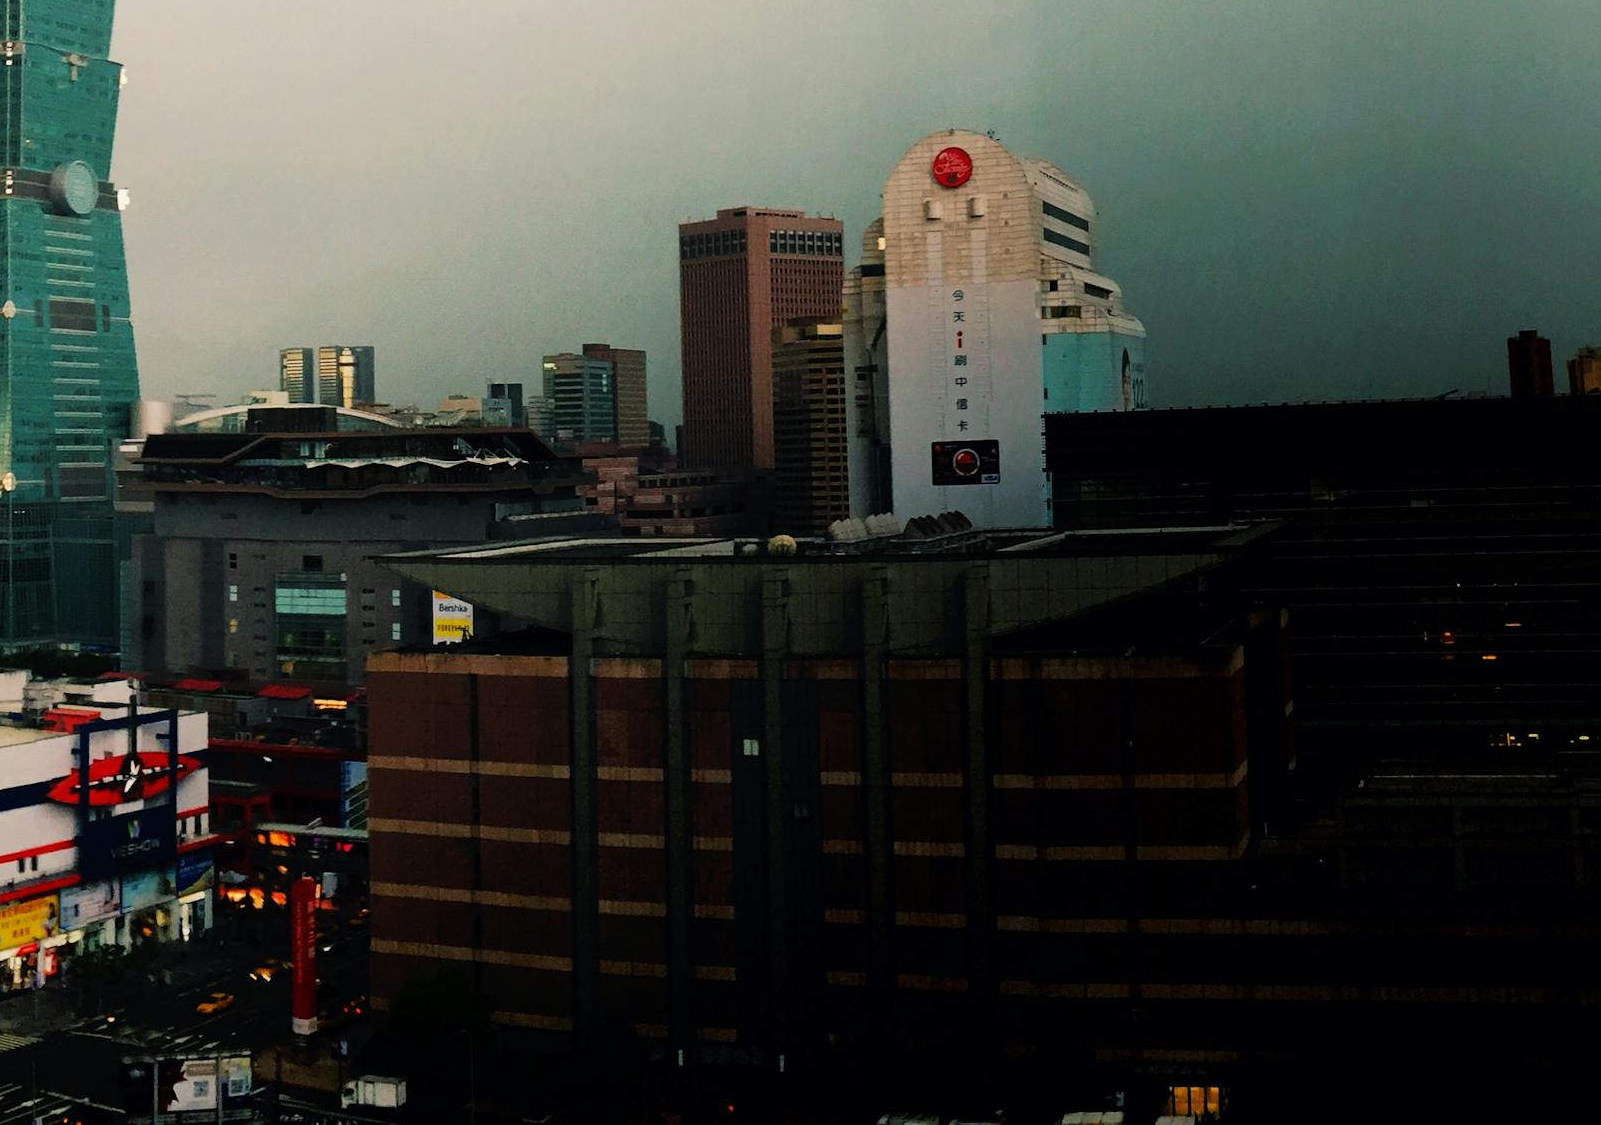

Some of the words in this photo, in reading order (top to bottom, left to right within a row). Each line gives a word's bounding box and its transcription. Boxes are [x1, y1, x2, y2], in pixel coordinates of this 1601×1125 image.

[952, 289, 969, 432] 今天i刷中信卡
[439, 604, 468, 612] Bershka
